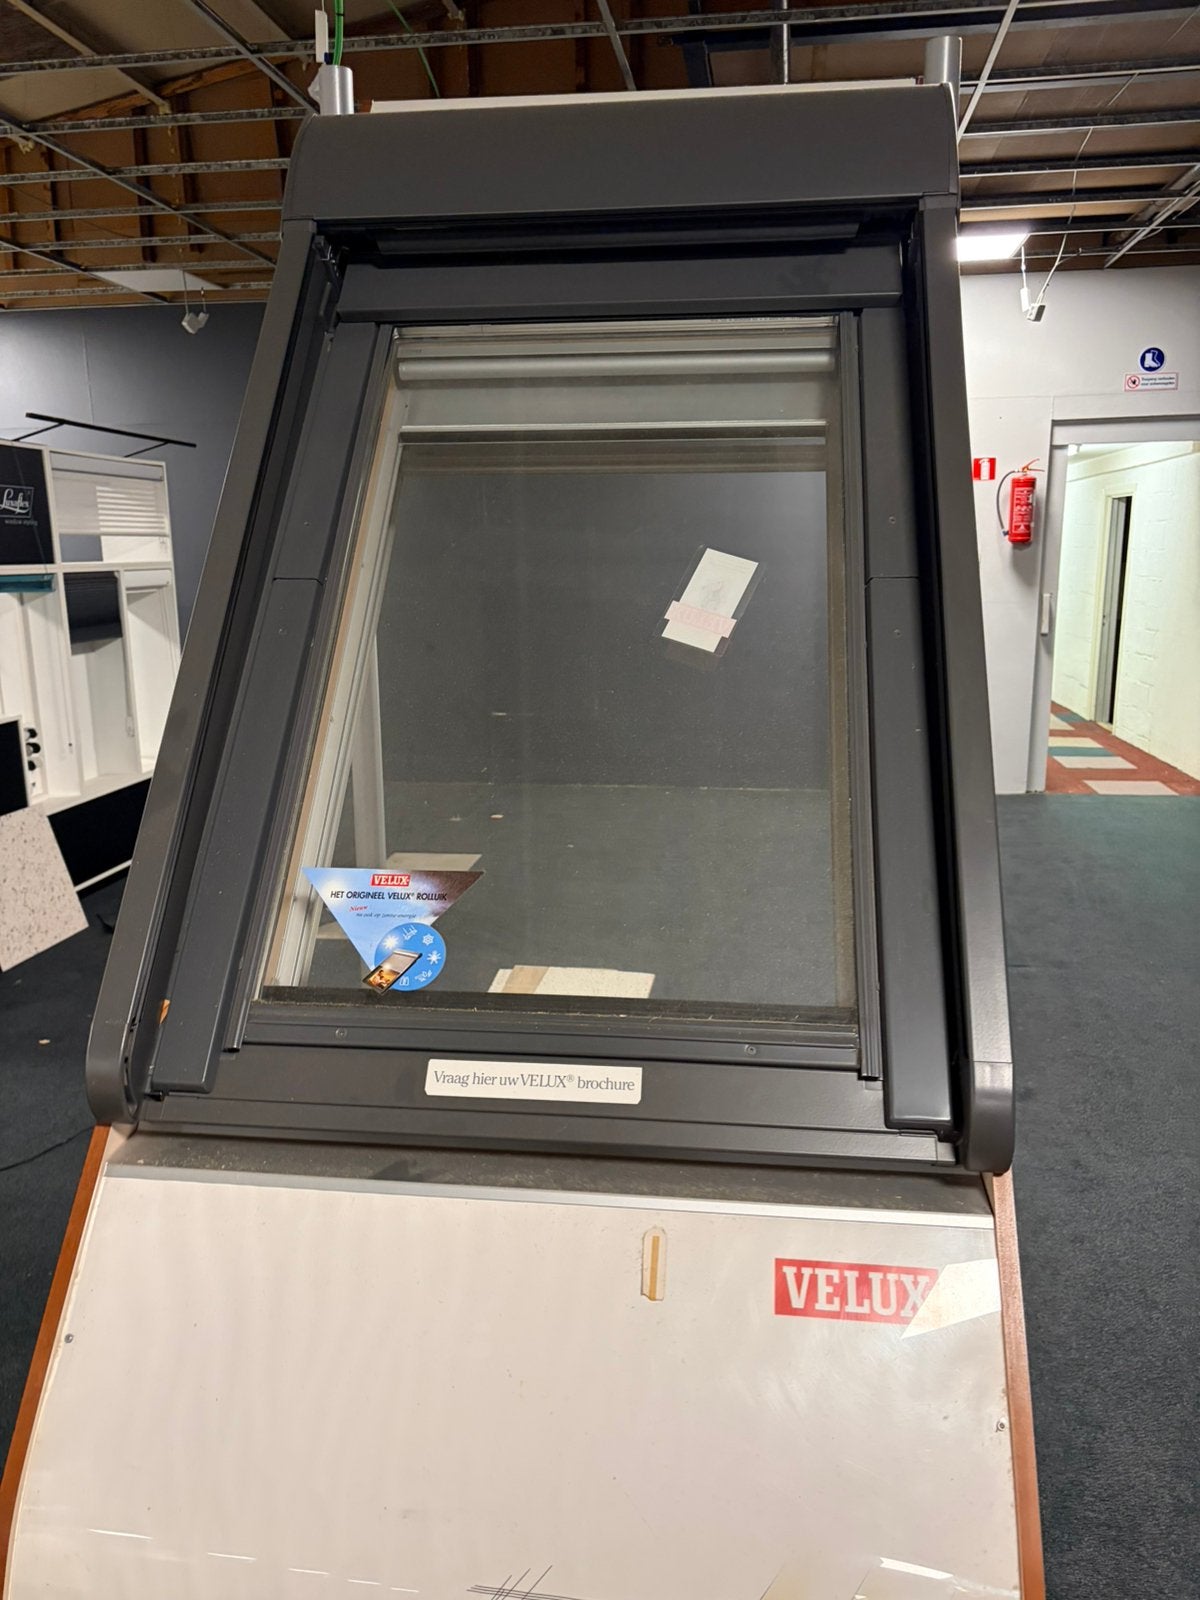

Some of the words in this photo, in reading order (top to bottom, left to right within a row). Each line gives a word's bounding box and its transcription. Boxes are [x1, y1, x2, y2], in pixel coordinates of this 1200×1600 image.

[374, 874, 408, 886] VELUX
[330, 890, 345, 899] HET
[346, 891, 386, 900] ORIGINEEL
[416, 893, 448, 901] ROLLUIK
[433, 1070, 470, 1087] Vraag
[472, 1072, 497, 1086] hier
[499, 1076, 519, 1086] uw
[577, 1076, 635, 1091] brochure
[782, 1265, 930, 1318] VELUX
